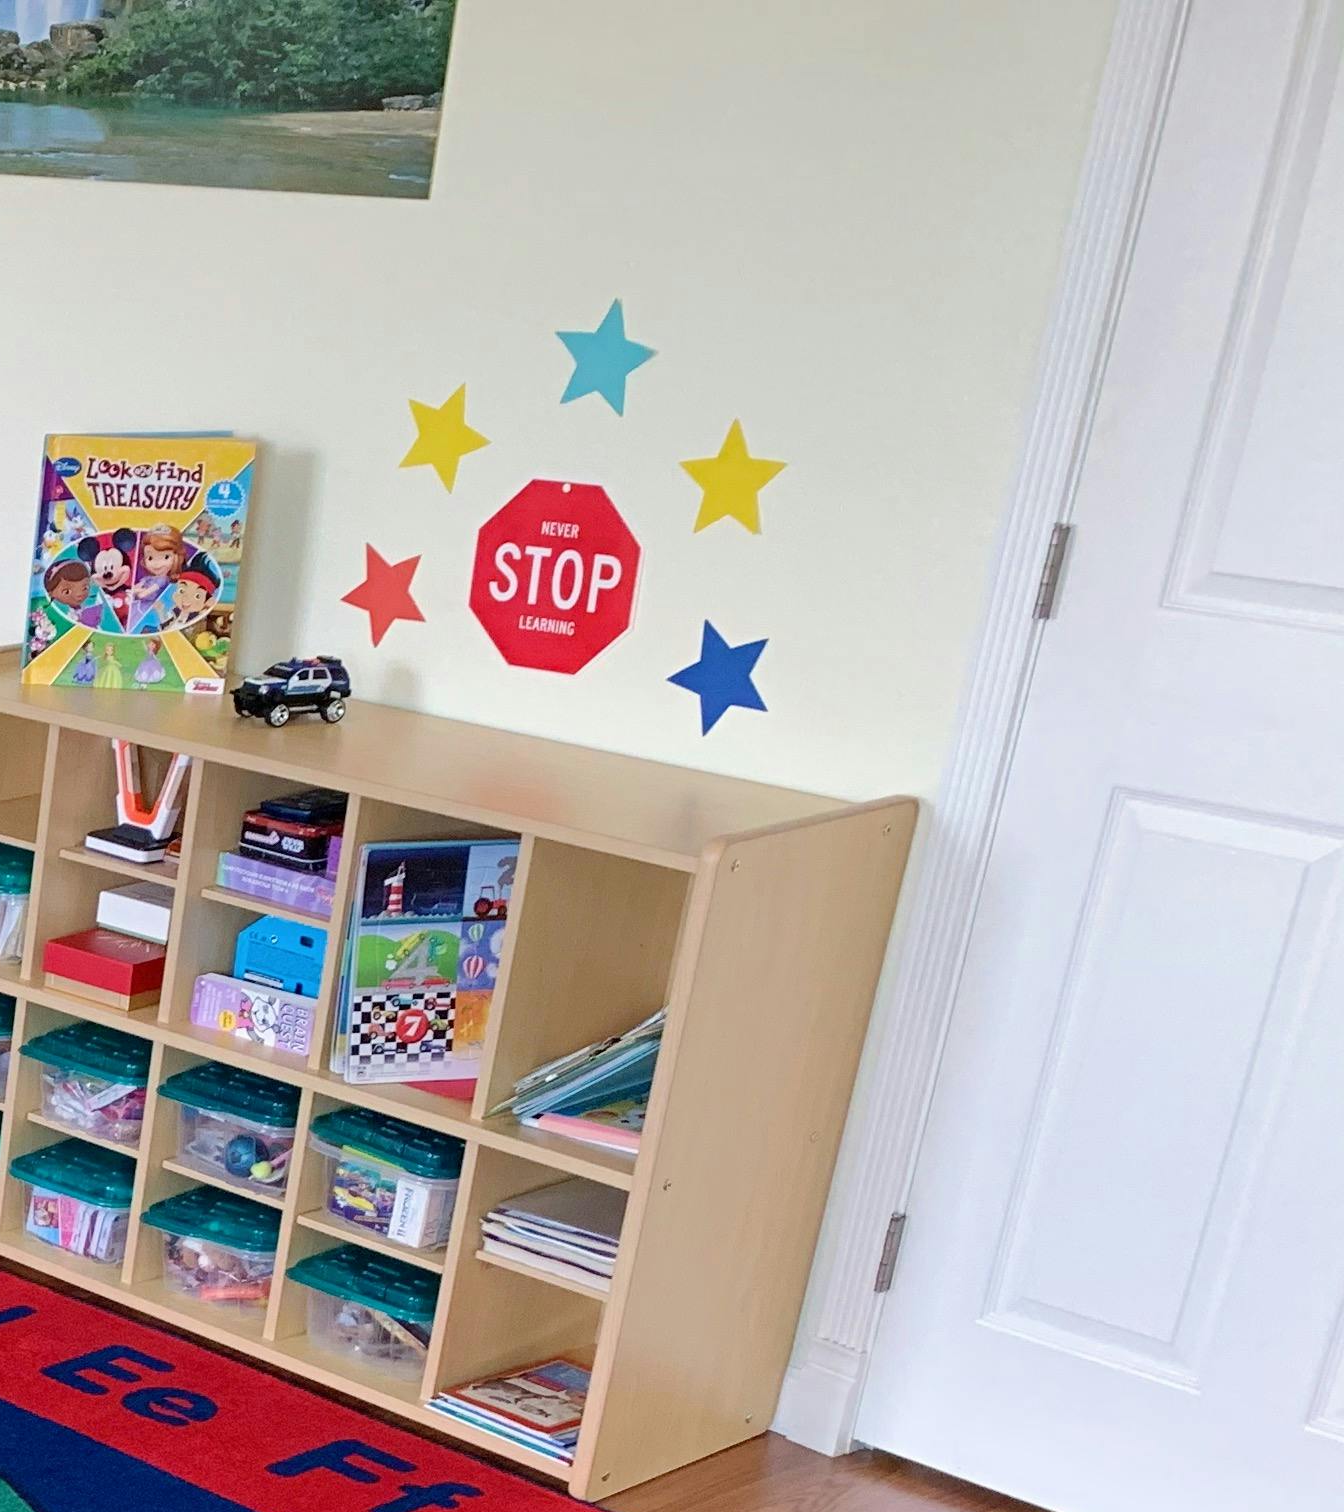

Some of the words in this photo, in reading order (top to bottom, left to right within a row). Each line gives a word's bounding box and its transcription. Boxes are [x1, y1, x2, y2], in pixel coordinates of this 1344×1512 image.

[86, 457, 134, 479] Look
[87, 482, 201, 511] TREASURY
[217, 483, 231, 498] 4
[541, 520, 580, 539] NEVER
[488, 541, 623, 614] STOP
[518, 614, 576, 637] LEARNING
[278, 1003, 296, 1049] QUEST
[289, 1007, 310, 1053] BRAIN
[402, 1015, 422, 1038] 7
[40, 1345, 219, 1426] Ee
